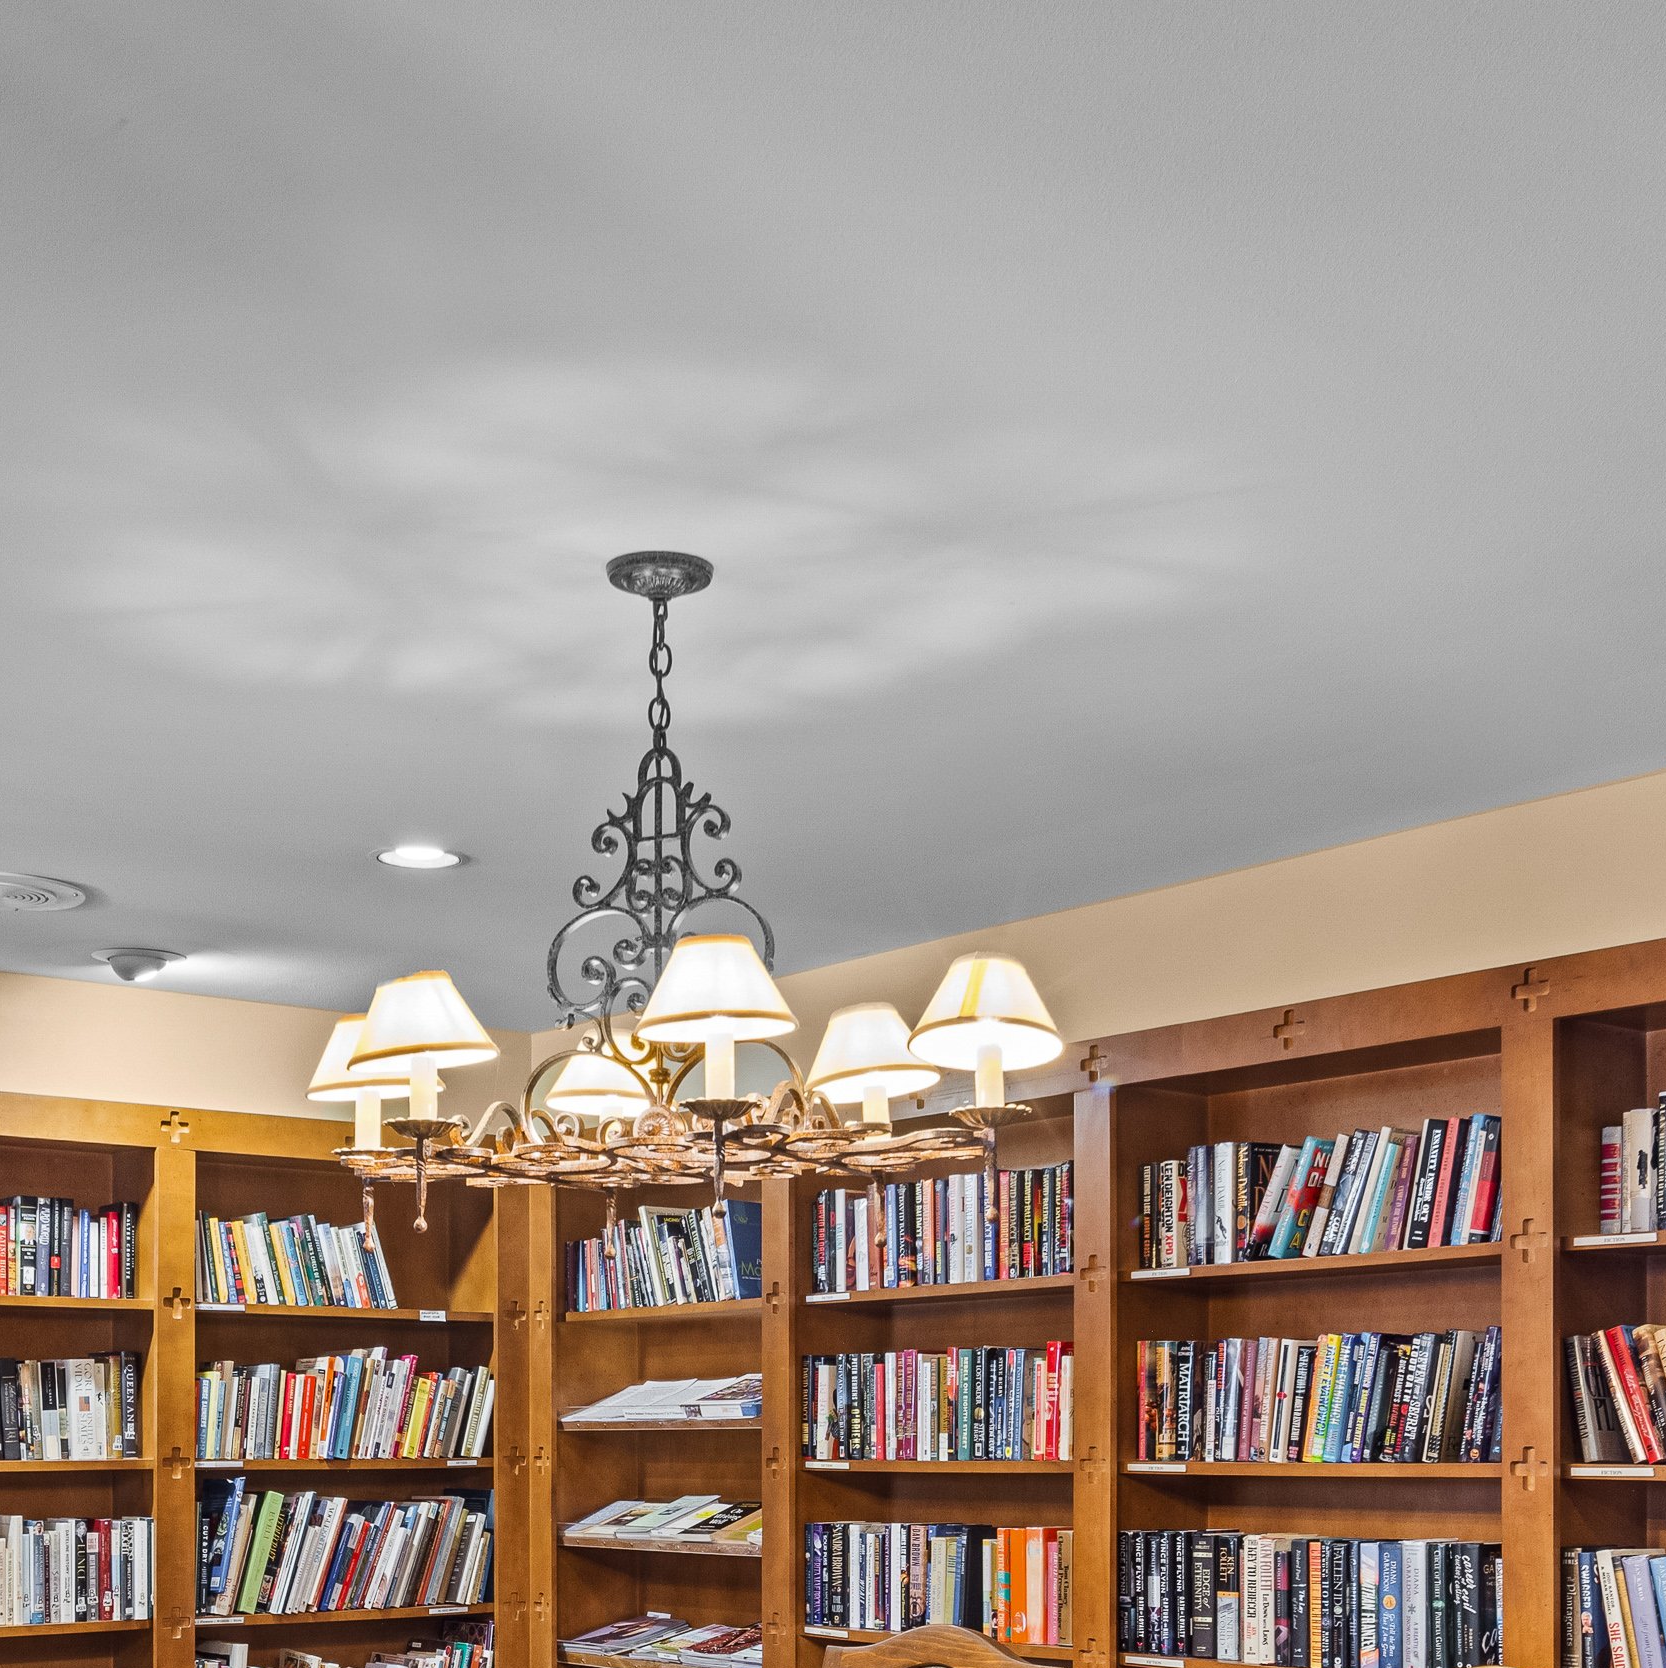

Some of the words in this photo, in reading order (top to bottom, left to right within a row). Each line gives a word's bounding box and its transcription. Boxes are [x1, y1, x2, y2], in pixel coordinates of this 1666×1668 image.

[1164, 1162, 1173, 1182] LEN
[1165, 1184, 1173, 1232] DEIGHTON
[1165, 1234, 1173, 1256] XPD
[961, 1384, 969, 1393] ON
[961, 1396, 969, 1421] EIGHTH
[1177, 1363, 1190, 1442] MATRIARCH
[1219, 1547, 1227, 1583] FOLLETT
[1227, 1556, 1235, 1574] KEN
[1195, 1562, 1203, 1612] ETERNITY
[1203, 1568, 1211, 1596] EDGE
[1203, 1597, 1211, 1608] of
[1563, 1584, 1577, 1647] Plantagenets
[1608, 1622, 1623, 1645] SHE
